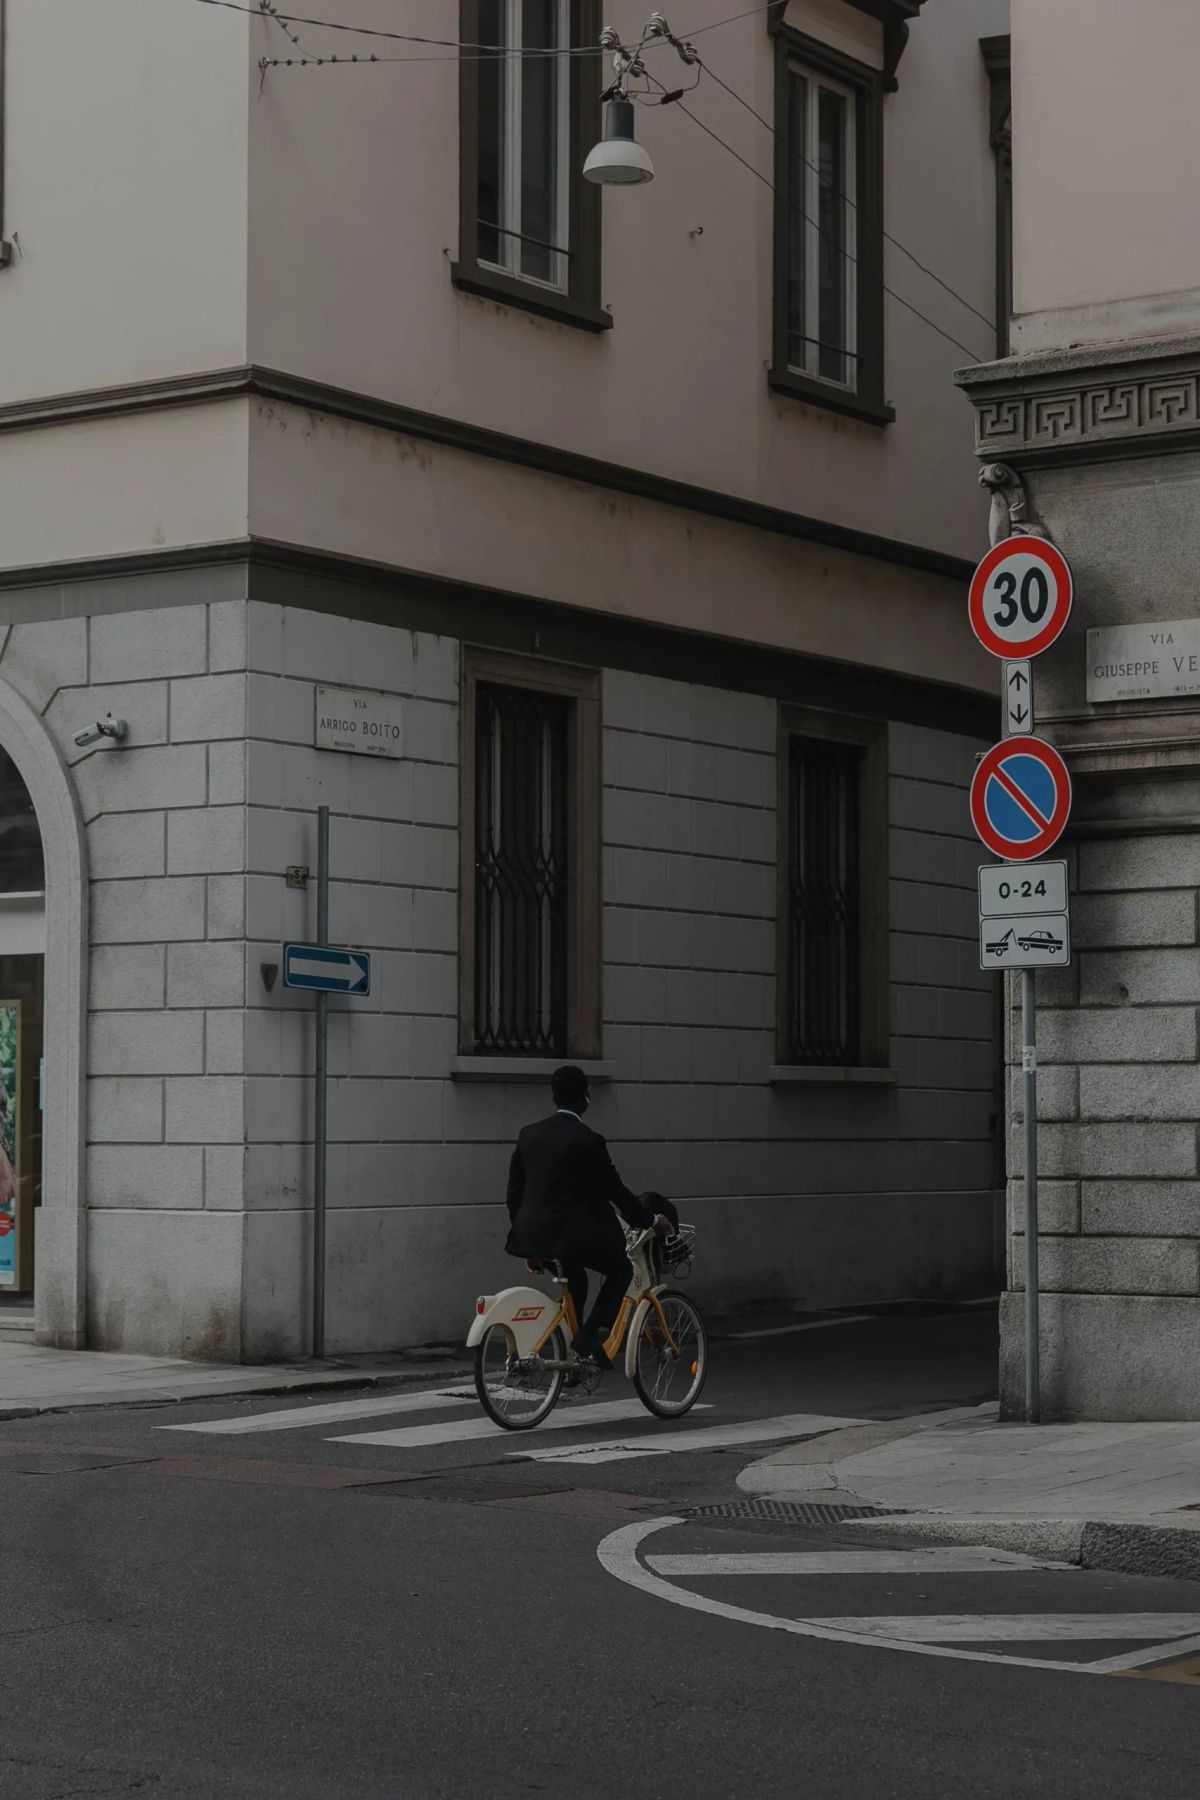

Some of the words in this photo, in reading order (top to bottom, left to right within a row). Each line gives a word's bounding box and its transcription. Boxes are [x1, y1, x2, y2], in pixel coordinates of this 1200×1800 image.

[993, 567, 1048, 627] 30
[1150, 633, 1174, 645] VIA
[1094, 661, 1159, 679] GIUSEPPE
[1172, 655, 1198, 673] VE
[353, 698, 368, 711] VIA
[320, 717, 357, 733] ARRIGO
[362, 721, 400, 739] BOITO
[998, 880, 1047, 899] 0-24
